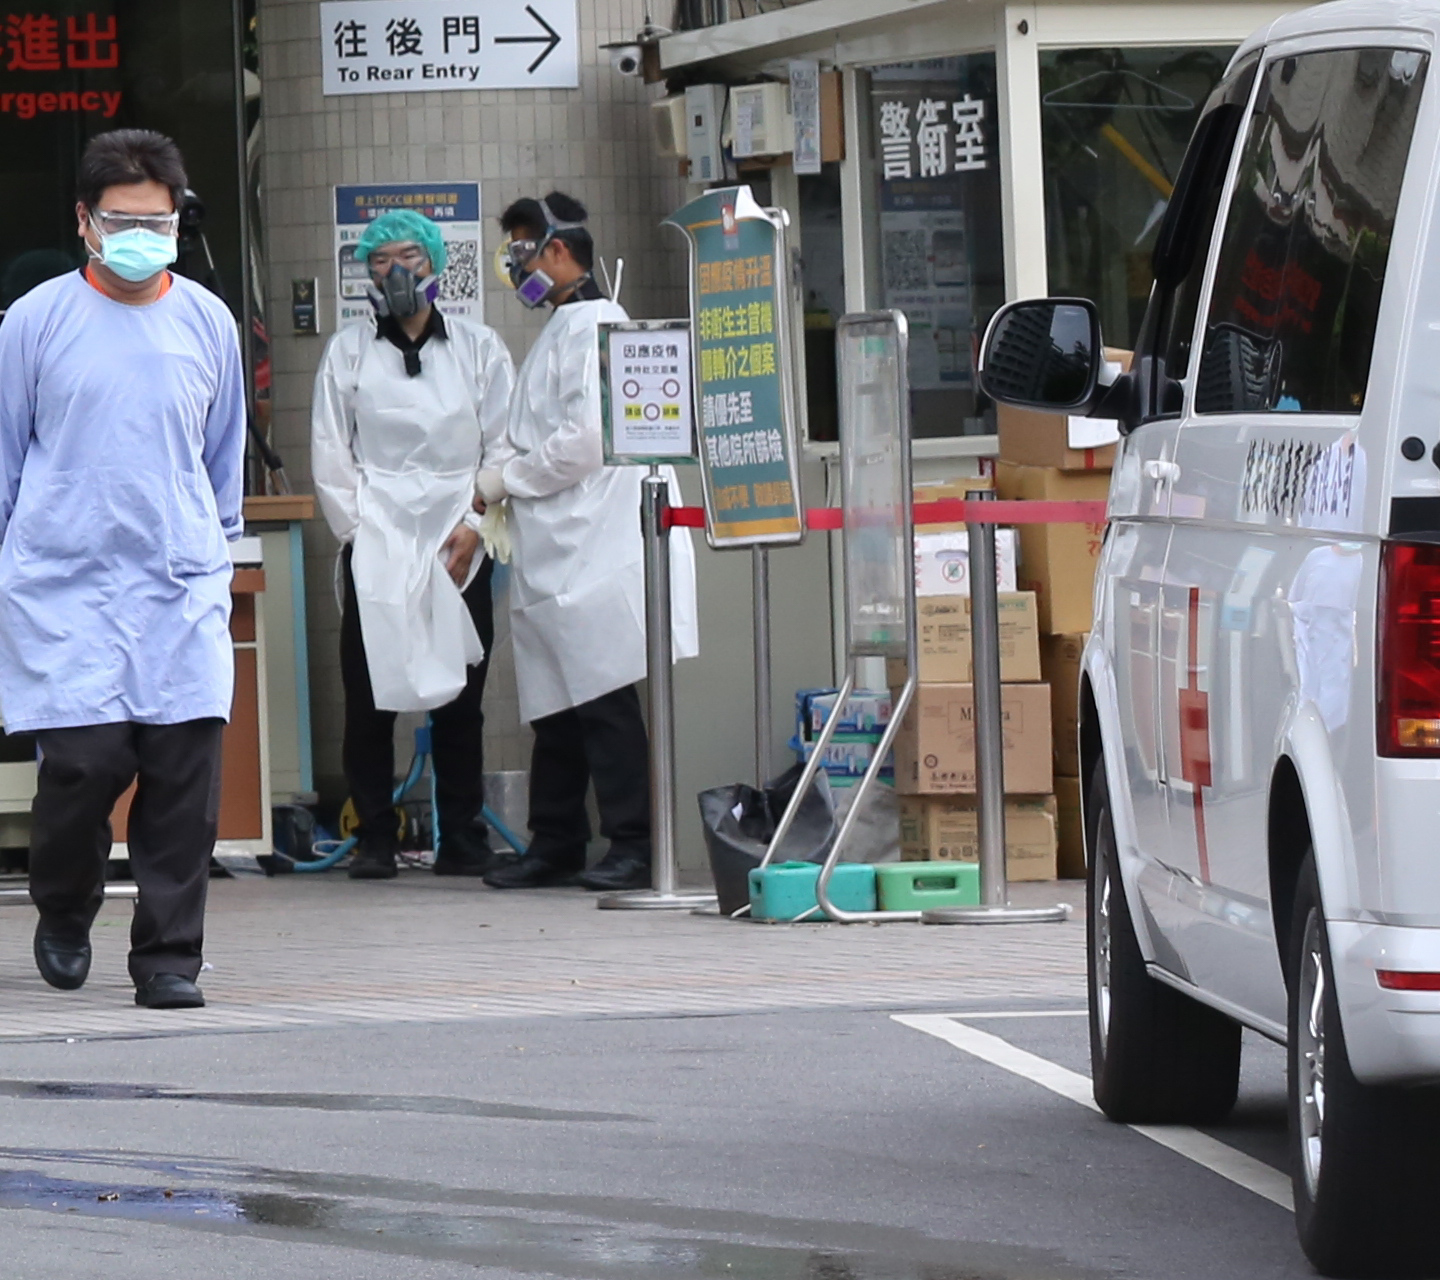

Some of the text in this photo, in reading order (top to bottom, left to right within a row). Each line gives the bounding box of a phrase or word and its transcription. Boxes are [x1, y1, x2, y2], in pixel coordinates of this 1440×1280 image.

[334, 16, 481, 59] 往後門
[337, 63, 480, 82] To Rear Entry
[880, 93, 986, 180] 警衛室
[623, 344, 678, 358] 因應疫情
